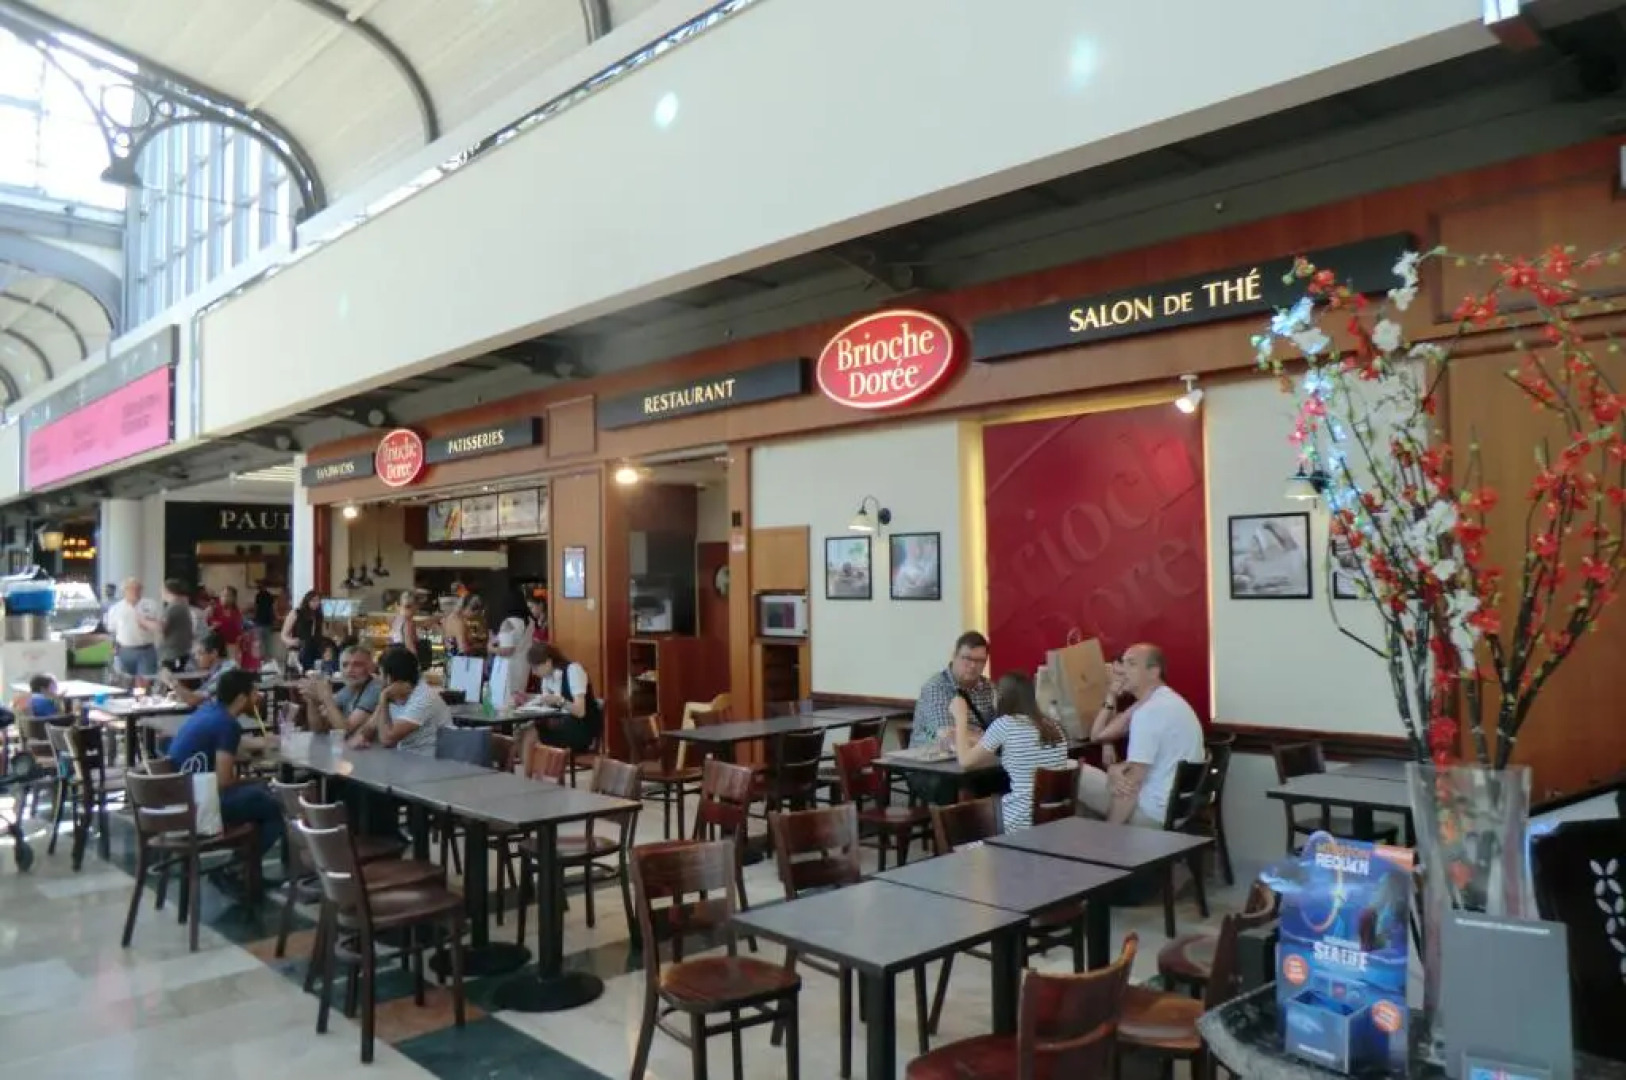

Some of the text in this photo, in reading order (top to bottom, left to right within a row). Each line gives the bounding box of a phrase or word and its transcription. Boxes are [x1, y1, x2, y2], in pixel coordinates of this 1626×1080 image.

[1069, 267, 1262, 333] SALON DE THÉ
[837, 323, 935, 372] Brioche
[643, 378, 736, 415] RESTAURANT
[849, 358, 919, 399] Dorée
[448, 429, 505, 454] PATISSERIES
